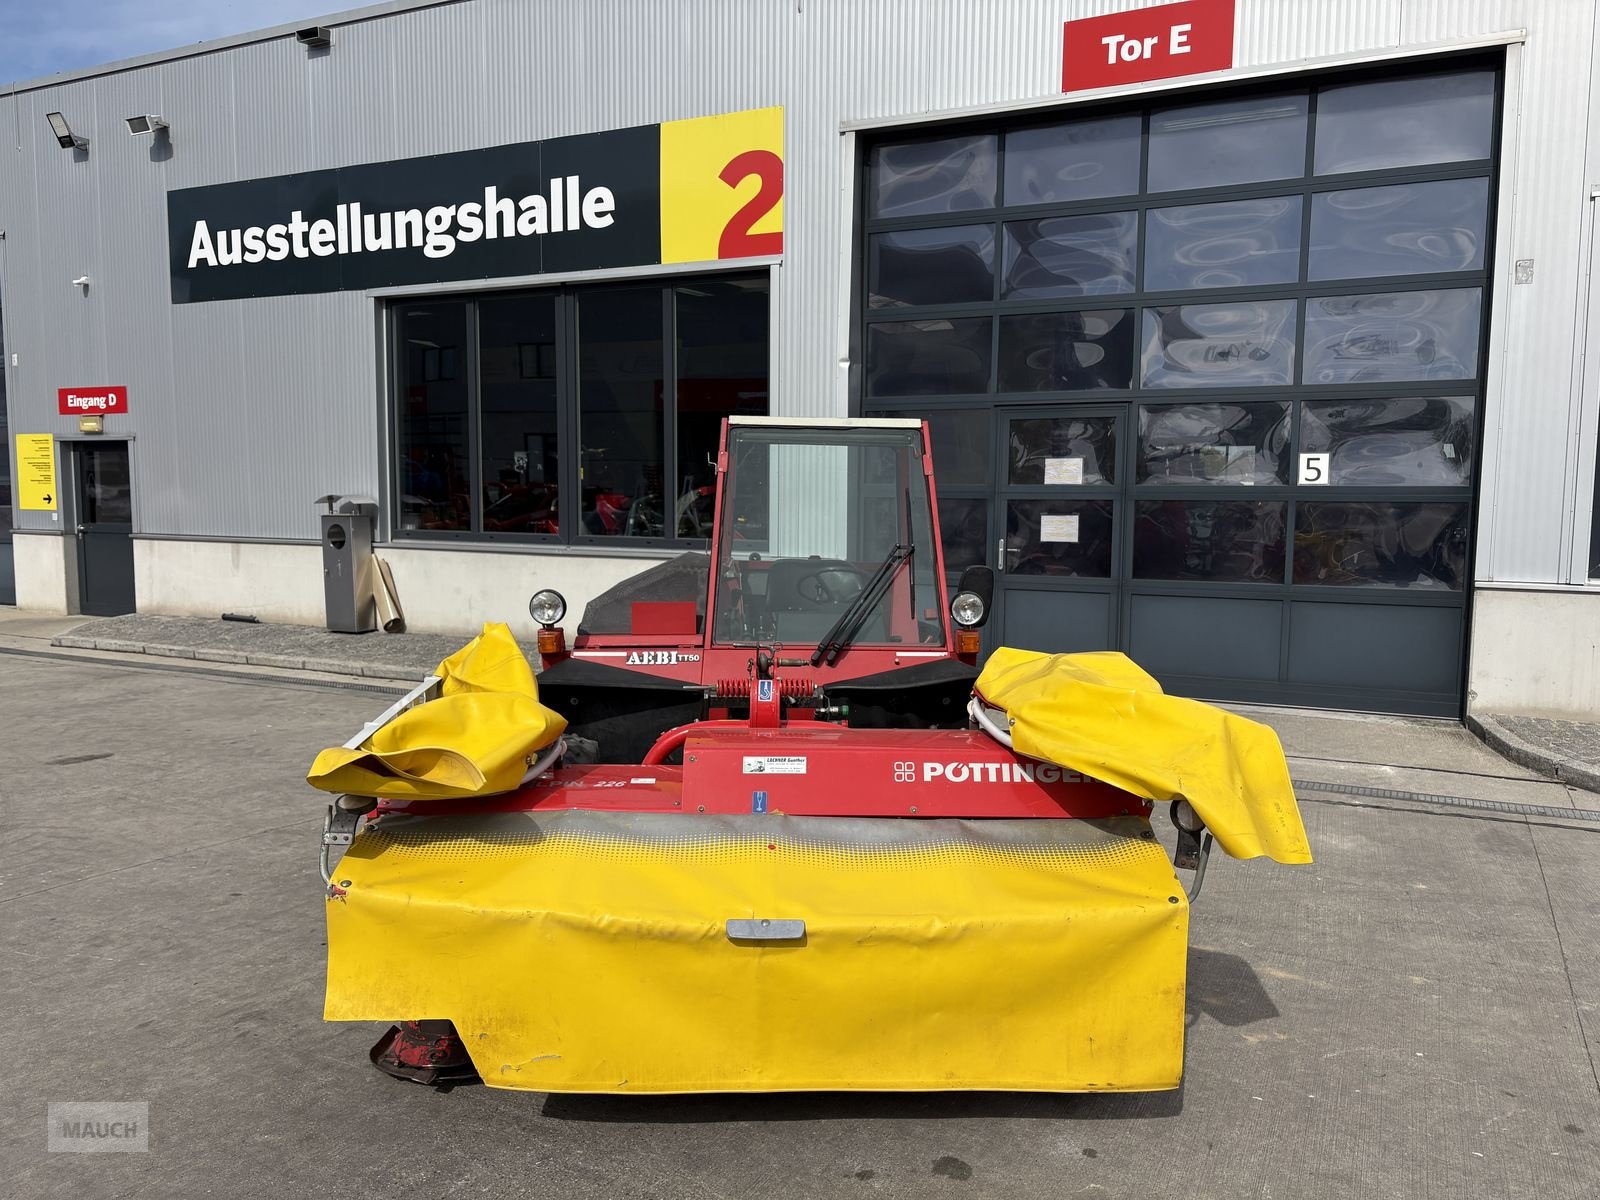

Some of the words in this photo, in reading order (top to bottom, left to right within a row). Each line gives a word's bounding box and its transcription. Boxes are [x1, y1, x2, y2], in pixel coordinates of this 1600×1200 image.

[1102, 34, 1158, 65] Tor
[1169, 23, 1192, 55] E
[187, 175, 616, 268] Ausstellungshalle
[718, 150, 784, 260] 2
[67, 394, 107, 410] Eingang
[108, 393, 117, 406] D
[1304, 457, 1322, 482] 5
[625, 651, 678, 665] AEBI
[678, 654, 700, 662] TT50
[923, 761, 1101, 783] PÖTTINGE
[593, 780, 627, 788] 226
